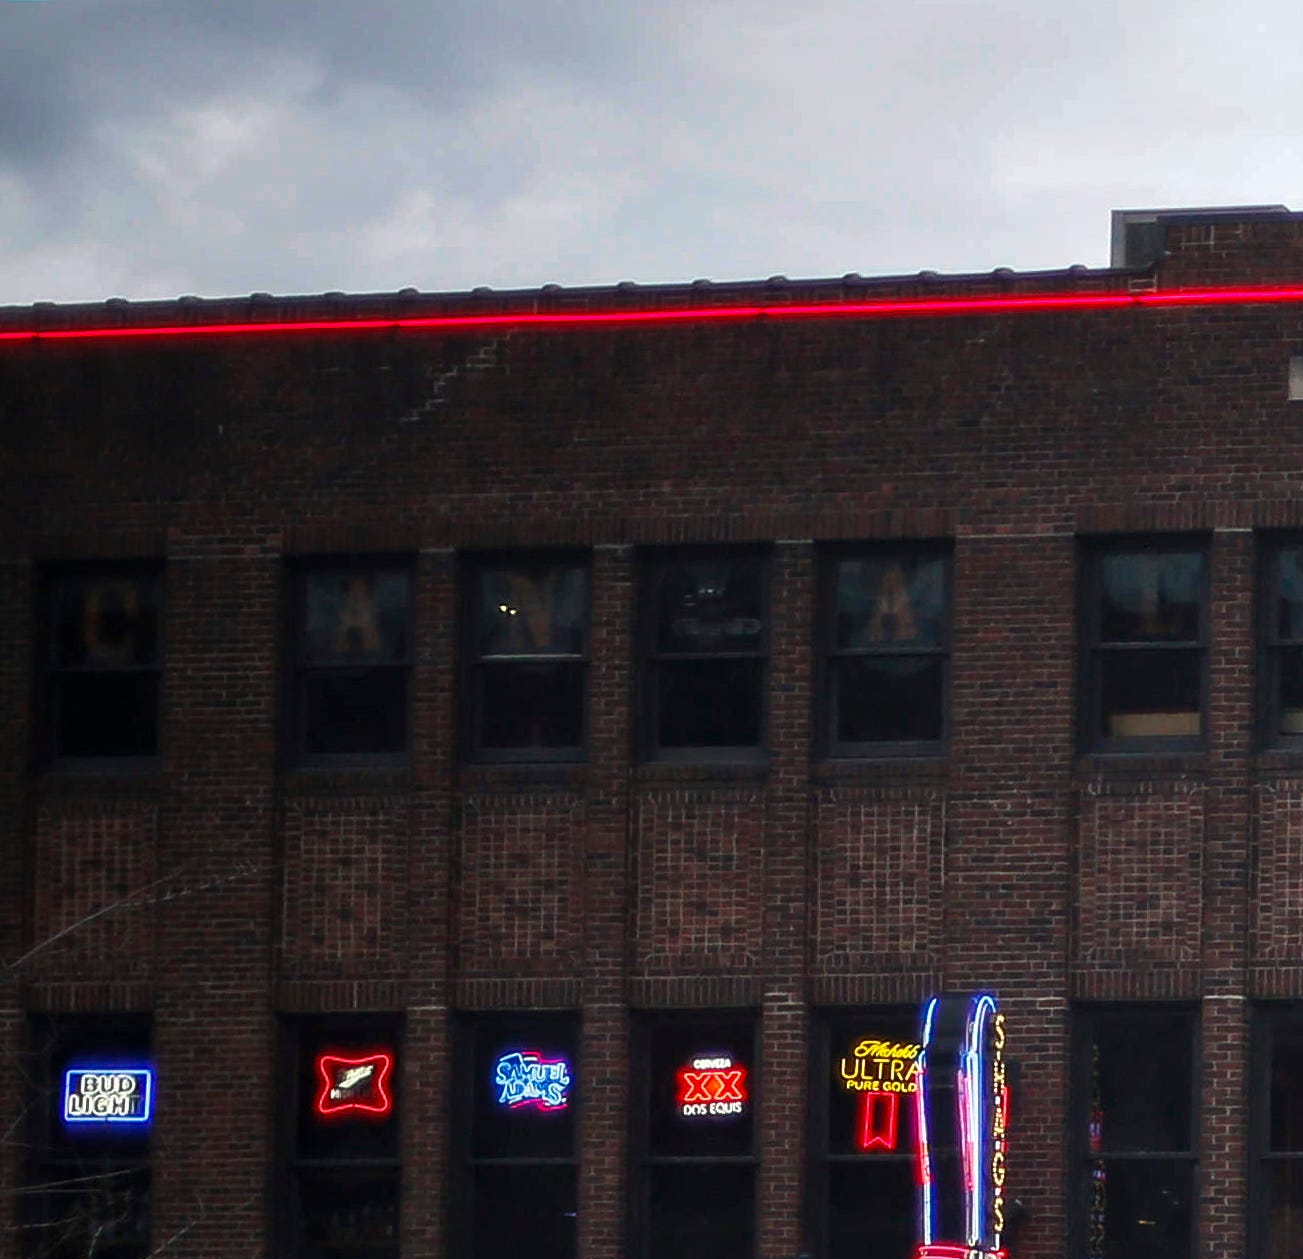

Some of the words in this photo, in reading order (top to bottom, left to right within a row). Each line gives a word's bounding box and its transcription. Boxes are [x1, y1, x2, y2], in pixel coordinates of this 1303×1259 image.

[496, 1062, 569, 1085] SAMUEL
[841, 1058, 921, 1080] ULTRA
[81, 1074, 136, 1096] BUD
[499, 1080, 566, 1105] ADAMS
[684, 1071, 743, 1101] XX
[846, 1080, 880, 1091] PURE
[882, 1081, 918, 1093] GOLD
[69, 1093, 141, 1116] LIGHT
[683, 1103, 707, 1116] DOS
[709, 1101, 742, 1115] EQUIS
